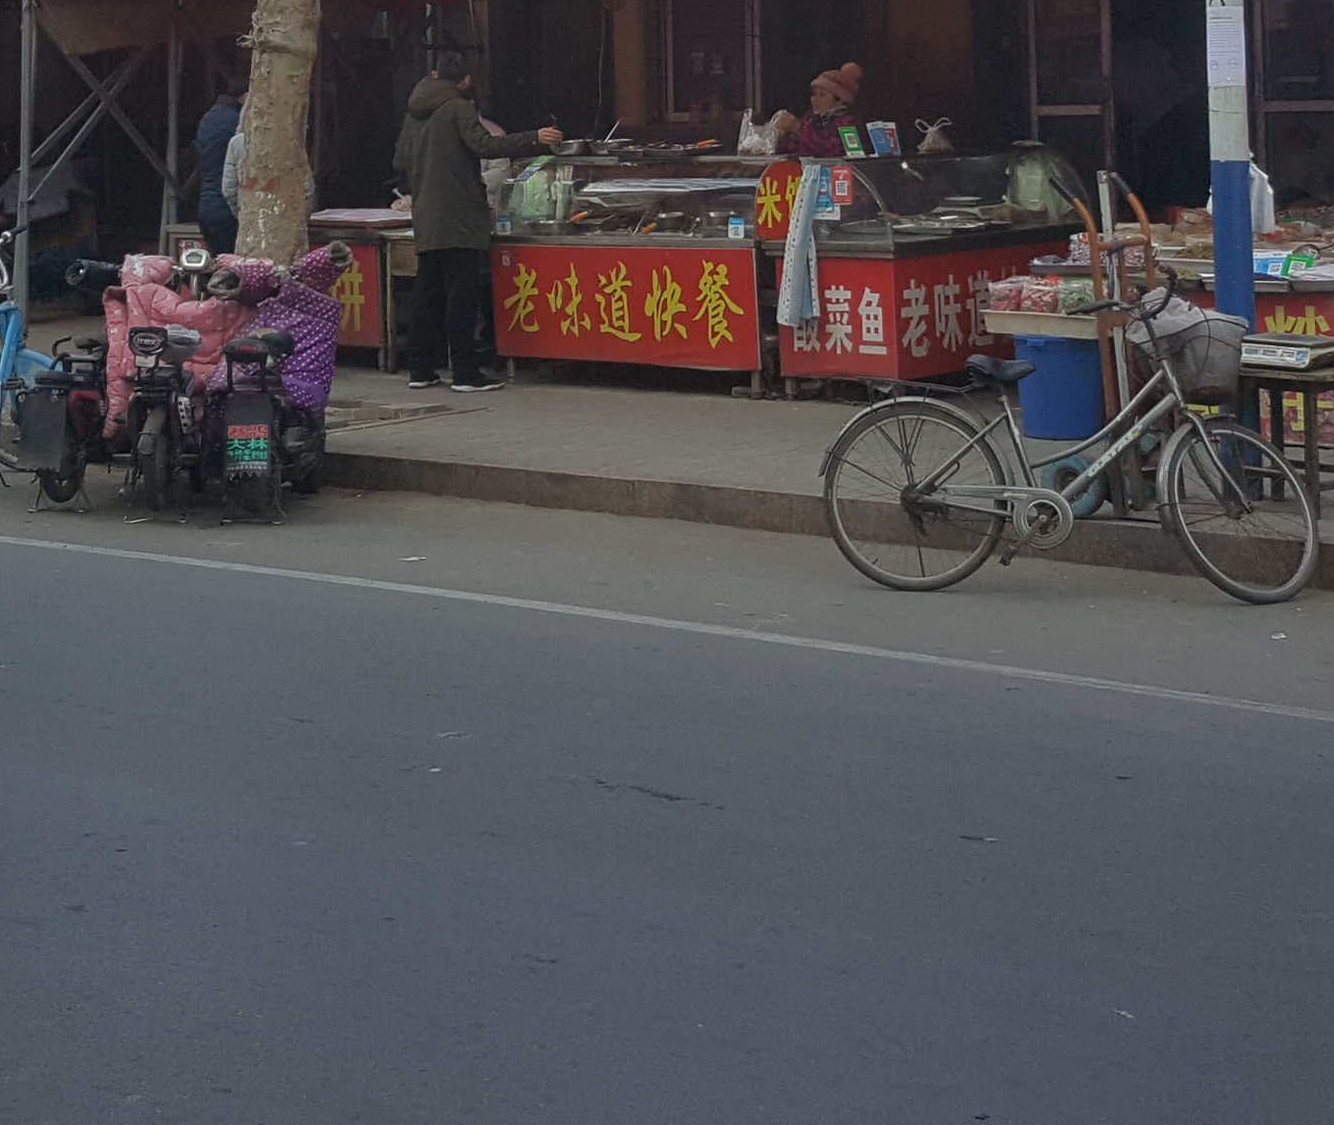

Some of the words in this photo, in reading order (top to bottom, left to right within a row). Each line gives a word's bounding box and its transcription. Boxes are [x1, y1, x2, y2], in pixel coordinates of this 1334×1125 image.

[503, 259, 745, 350] 老味道快餐
[901, 265, 1017, 358] 老味道
